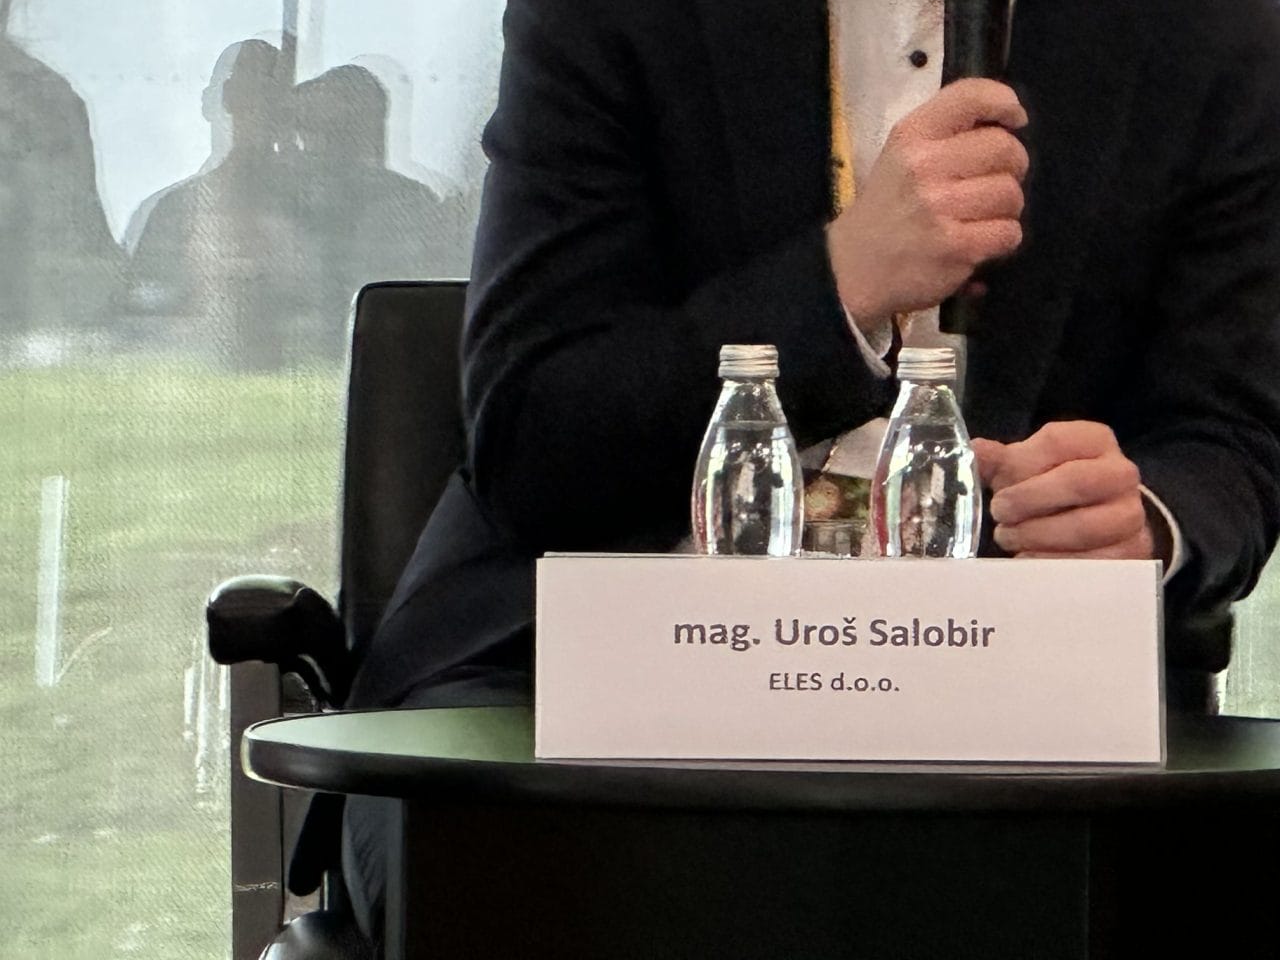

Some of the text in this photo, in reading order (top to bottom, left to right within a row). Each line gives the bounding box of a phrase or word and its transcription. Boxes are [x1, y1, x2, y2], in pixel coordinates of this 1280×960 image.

[674, 616, 996, 652] mag. Uroš Salobir
[769, 671, 900, 693] ELES d.o.o.
